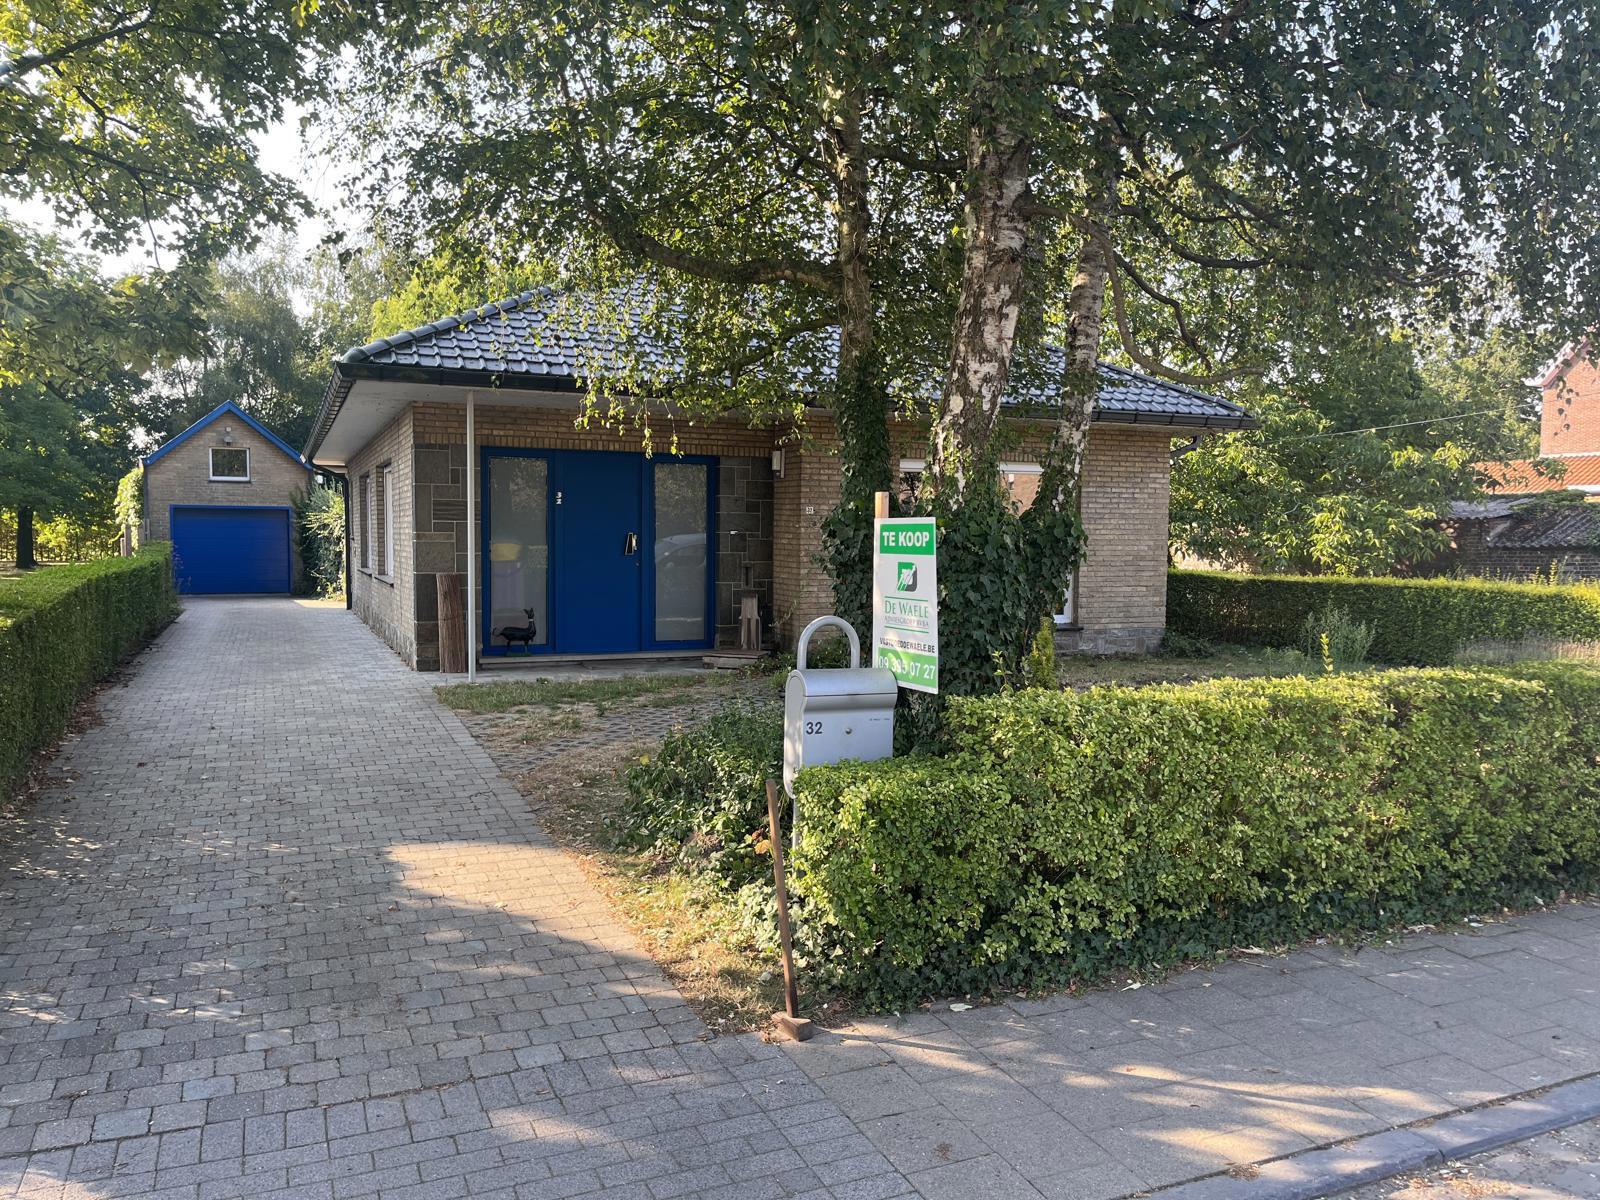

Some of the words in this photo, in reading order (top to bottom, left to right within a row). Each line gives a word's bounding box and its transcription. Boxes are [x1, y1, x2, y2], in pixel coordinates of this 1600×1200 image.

[882, 531, 896, 547] TE
[898, 531, 930, 547] KOOP
[909, 661, 921, 677] 07
[923, 664, 936, 680] 27
[805, 721, 823, 735] 32
